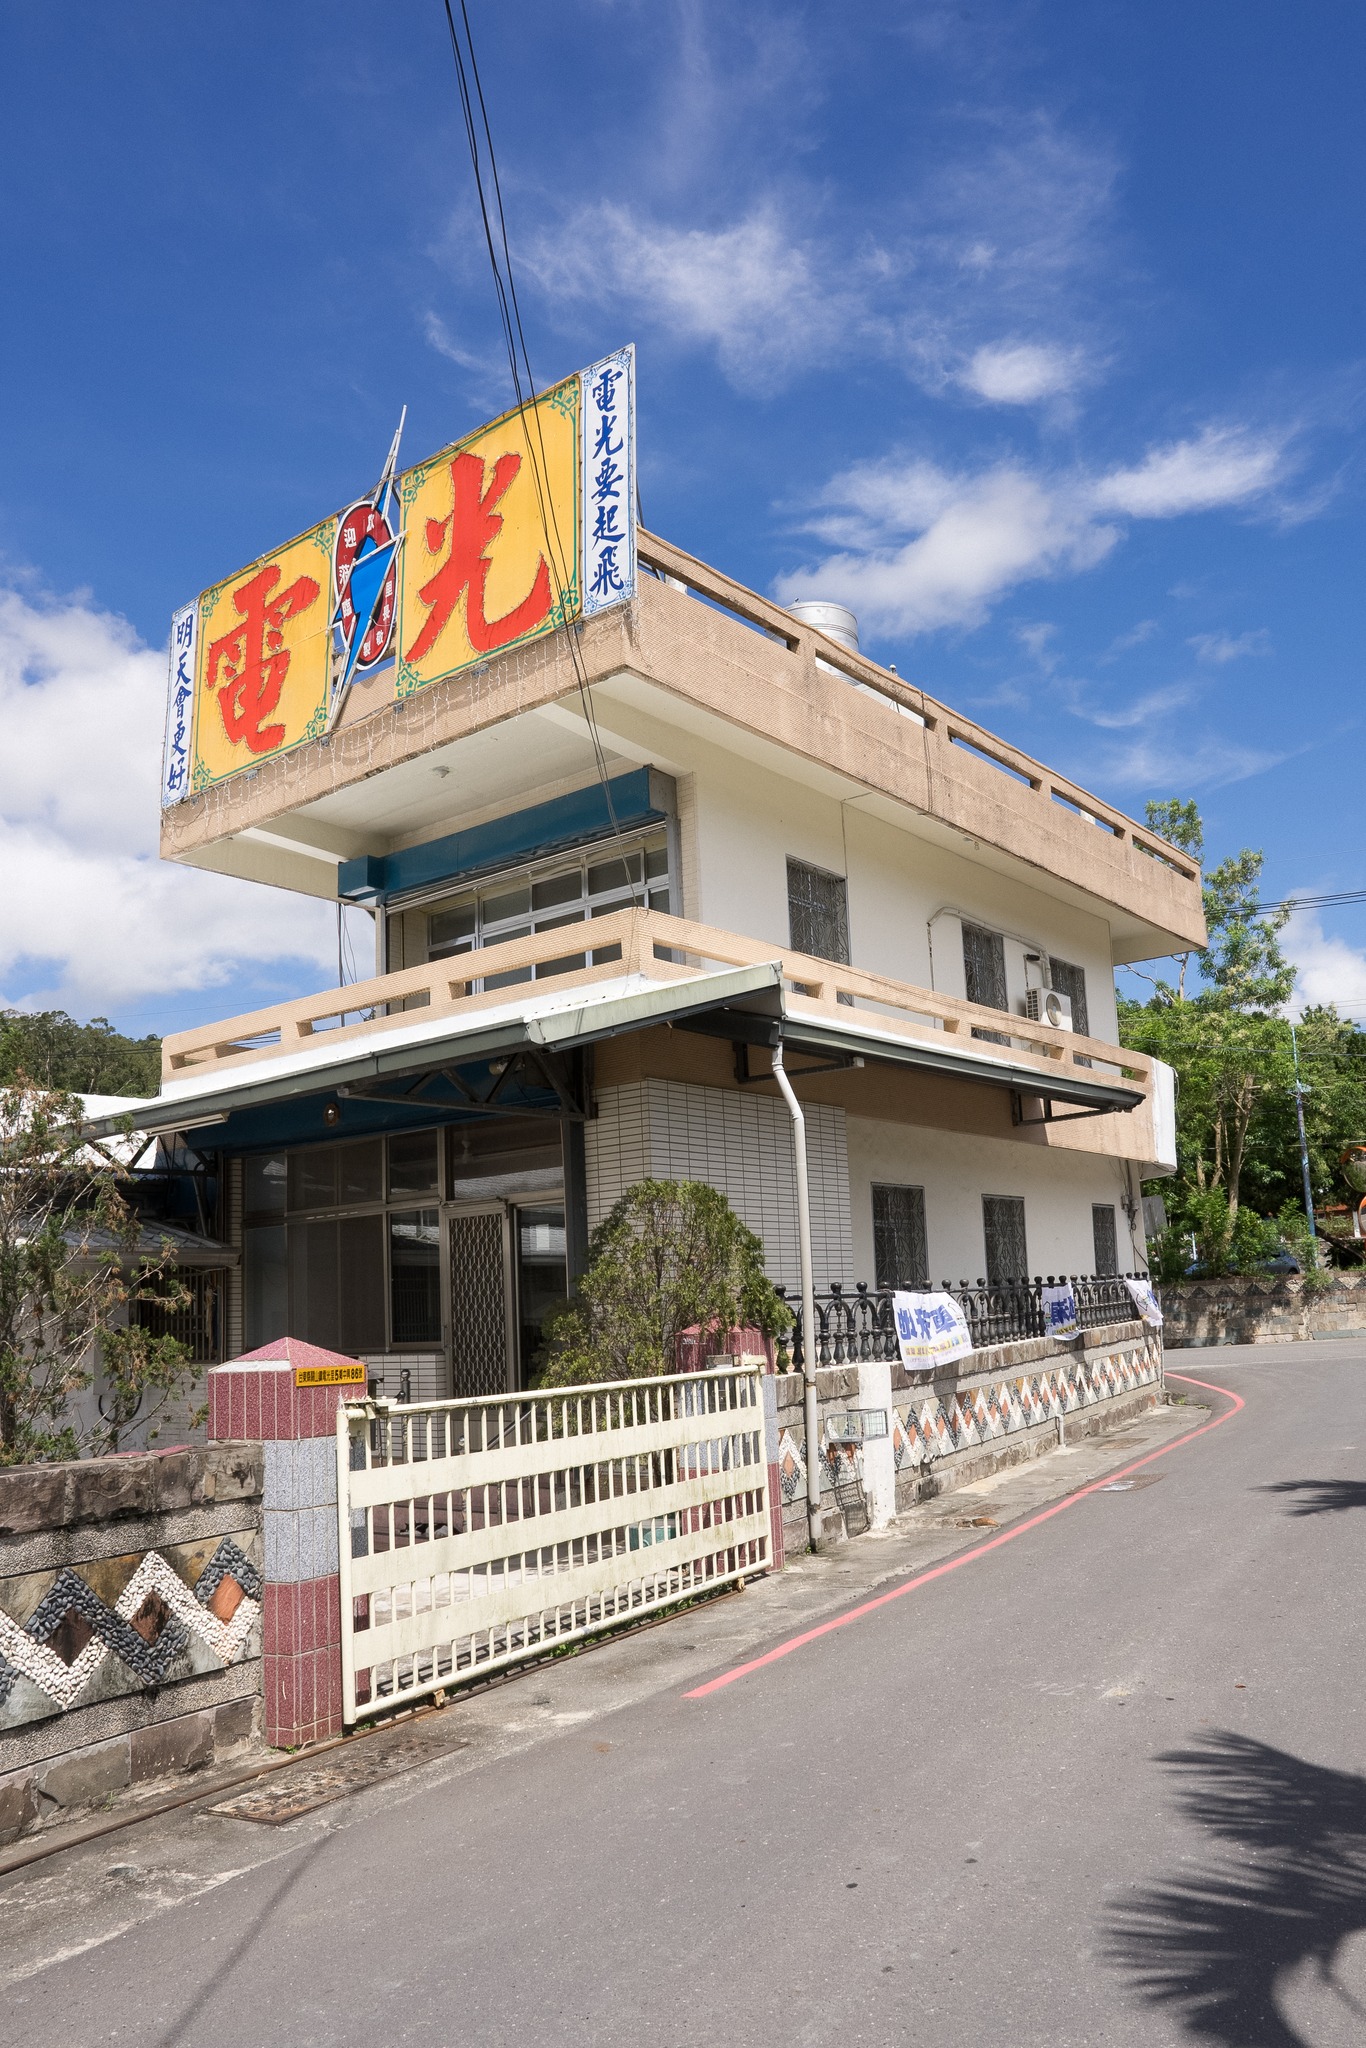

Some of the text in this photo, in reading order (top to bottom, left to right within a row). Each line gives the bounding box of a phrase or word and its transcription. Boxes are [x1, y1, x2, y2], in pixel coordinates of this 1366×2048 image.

[589, 368, 626, 597] 電光要起飛
[167, 613, 194, 792] 明天會更好
